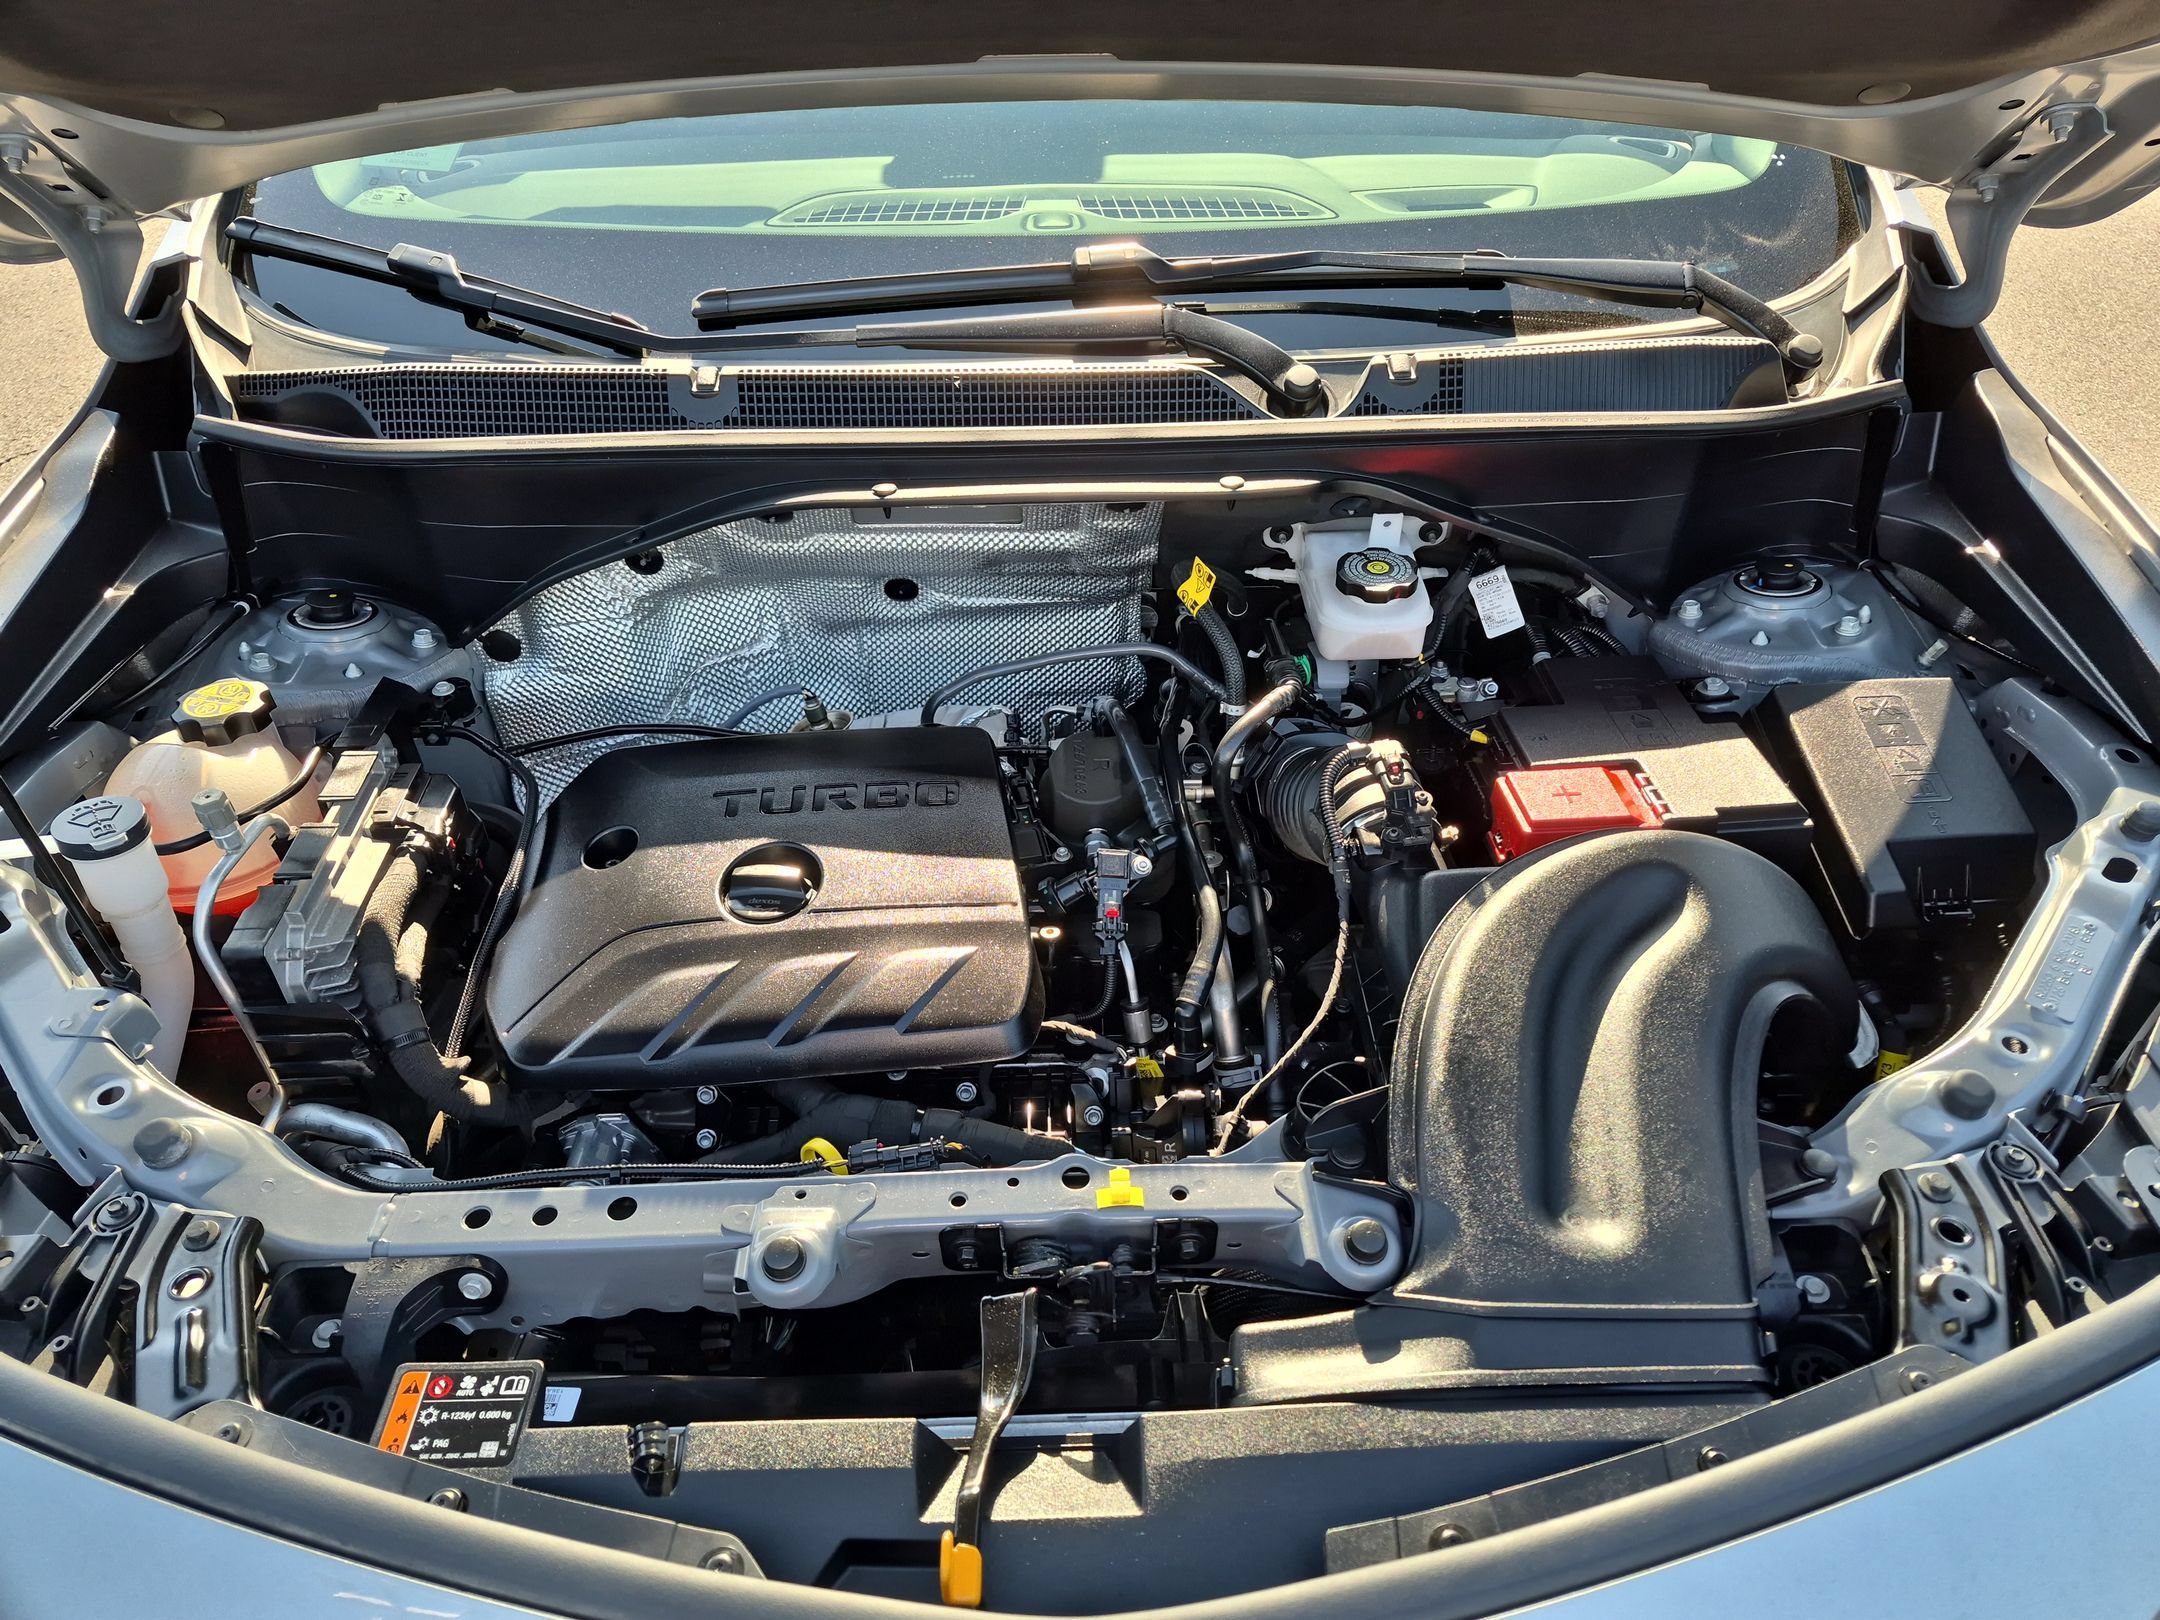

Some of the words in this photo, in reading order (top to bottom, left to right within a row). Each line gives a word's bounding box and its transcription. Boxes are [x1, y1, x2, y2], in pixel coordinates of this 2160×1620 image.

[1475, 574, 1500, 590] 6669
[712, 780, 960, 818] TURBO
[748, 897, 781, 905] dexos
[1164, 1141, 1175, 1152] R
[455, 1389, 475, 1397] AUTO
[440, 1410, 477, 1421] R-1234yf
[478, 1410, 501, 1420] 0.600
[501, 1409, 512, 1421] kg
[432, 1438, 451, 1448] PAG
